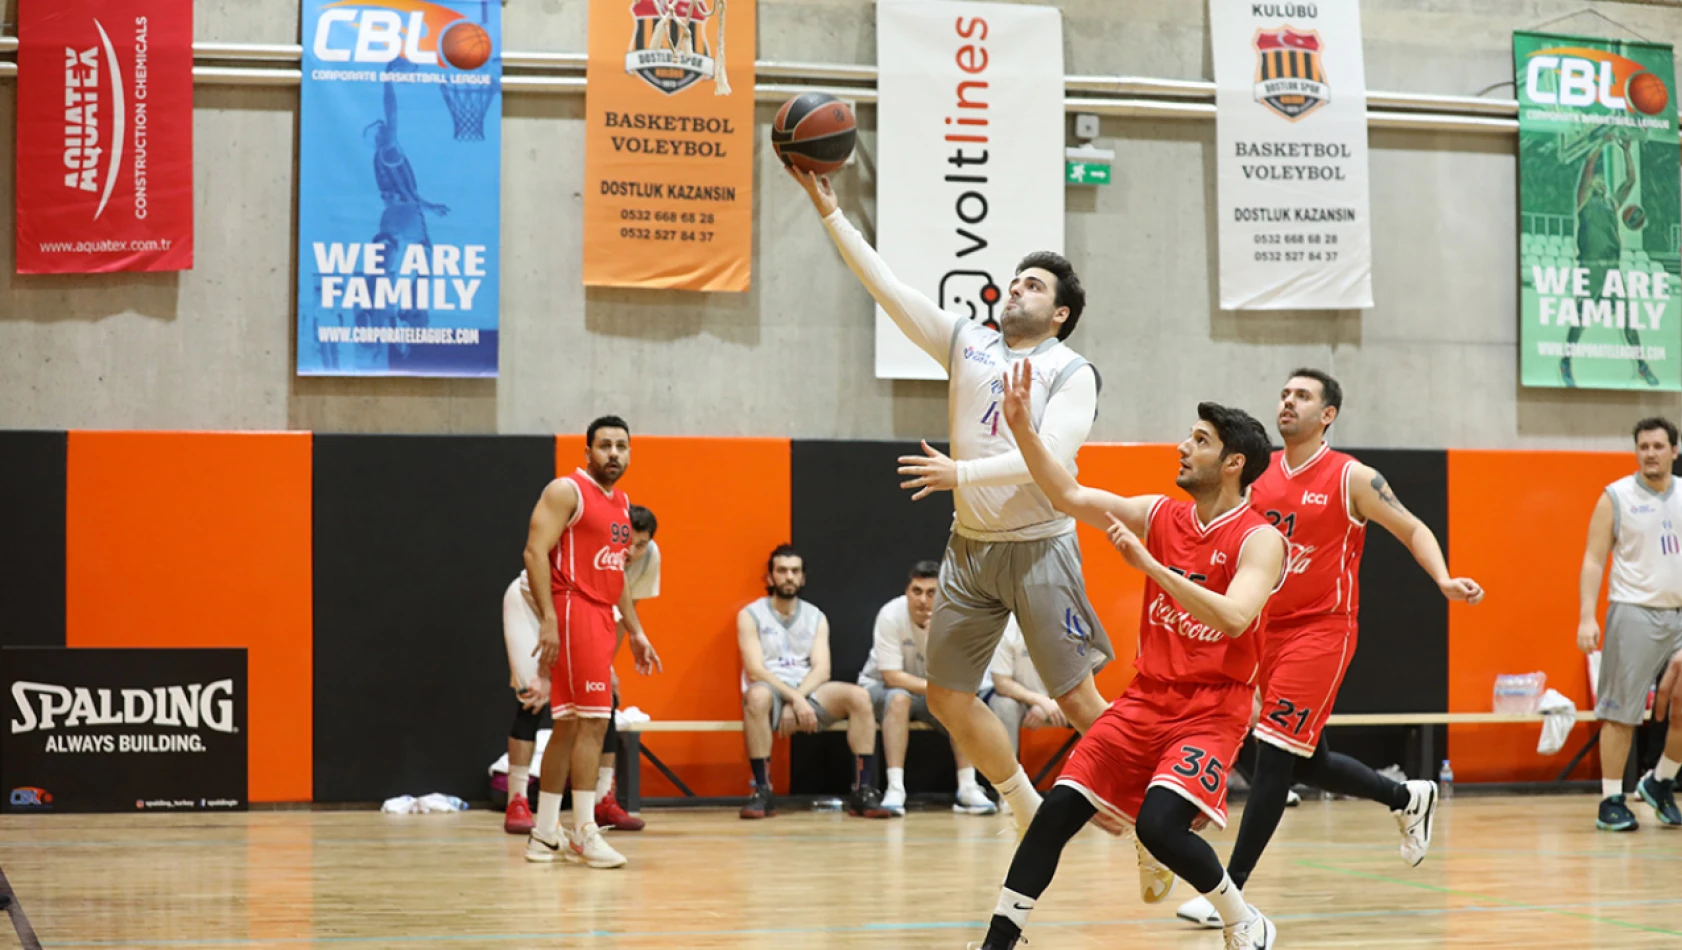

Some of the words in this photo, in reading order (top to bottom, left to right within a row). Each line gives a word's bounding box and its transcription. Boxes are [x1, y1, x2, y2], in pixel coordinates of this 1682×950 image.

[1251, 2, 1318, 18] KULÜBÜ
[313, 8, 439, 64] CBL
[135, 16, 148, 99] CHEMICALS
[312, 69, 377, 83] CORPORATE
[379, 71, 449, 84] BASKETBALL
[450, 73, 492, 85] LEAGUE
[1526, 55, 1627, 109] CBL
[64, 46, 102, 192] AQUATEX
[605, 111, 735, 134] BASKETBOL
[611, 136, 727, 158] VOLEYBOL
[944, 16, 989, 258] voltlines
[1235, 141, 1351, 158] BASKETBOL
[135, 103, 148, 220] CONSTRUCTION
[1242, 164, 1346, 181] VOLEYBOL
[600, 180, 663, 199] DOSTLUK
[667, 184, 736, 201] KAZANSIN
[620, 208, 651, 221] 0532
[1234, 207, 1291, 222] DOSTLUK
[1295, 207, 1356, 222] KAZANSIN
[40, 238, 172, 254] www.aquatex.com.tr
[619, 227, 650, 239] 0532
[654, 228, 677, 240] 527
[699, 231, 715, 242] 37
[1253, 234, 1281, 244] 0532
[312, 242, 386, 275] WE
[399, 243, 487, 277] ARE
[1253, 251, 1281, 261] 0532
[1284, 251, 1305, 261] 527
[1325, 251, 1339, 261] 37
[320, 276, 482, 311] FAMILY
[1532, 265, 1591, 297] WE
[1601, 268, 1671, 300] ARE
[1538, 296, 1667, 331] FAMILY
[317, 326, 480, 345] WWW.CORPORATELEAGUES.COM
[611, 522, 631, 545] 99
[11, 678, 234, 735] SPALDING
[1268, 698, 1311, 735] 21
[45, 734, 115, 753] ALWAYS
[118, 734, 207, 753] BUILDING.
[1172, 744, 1223, 793] 35
